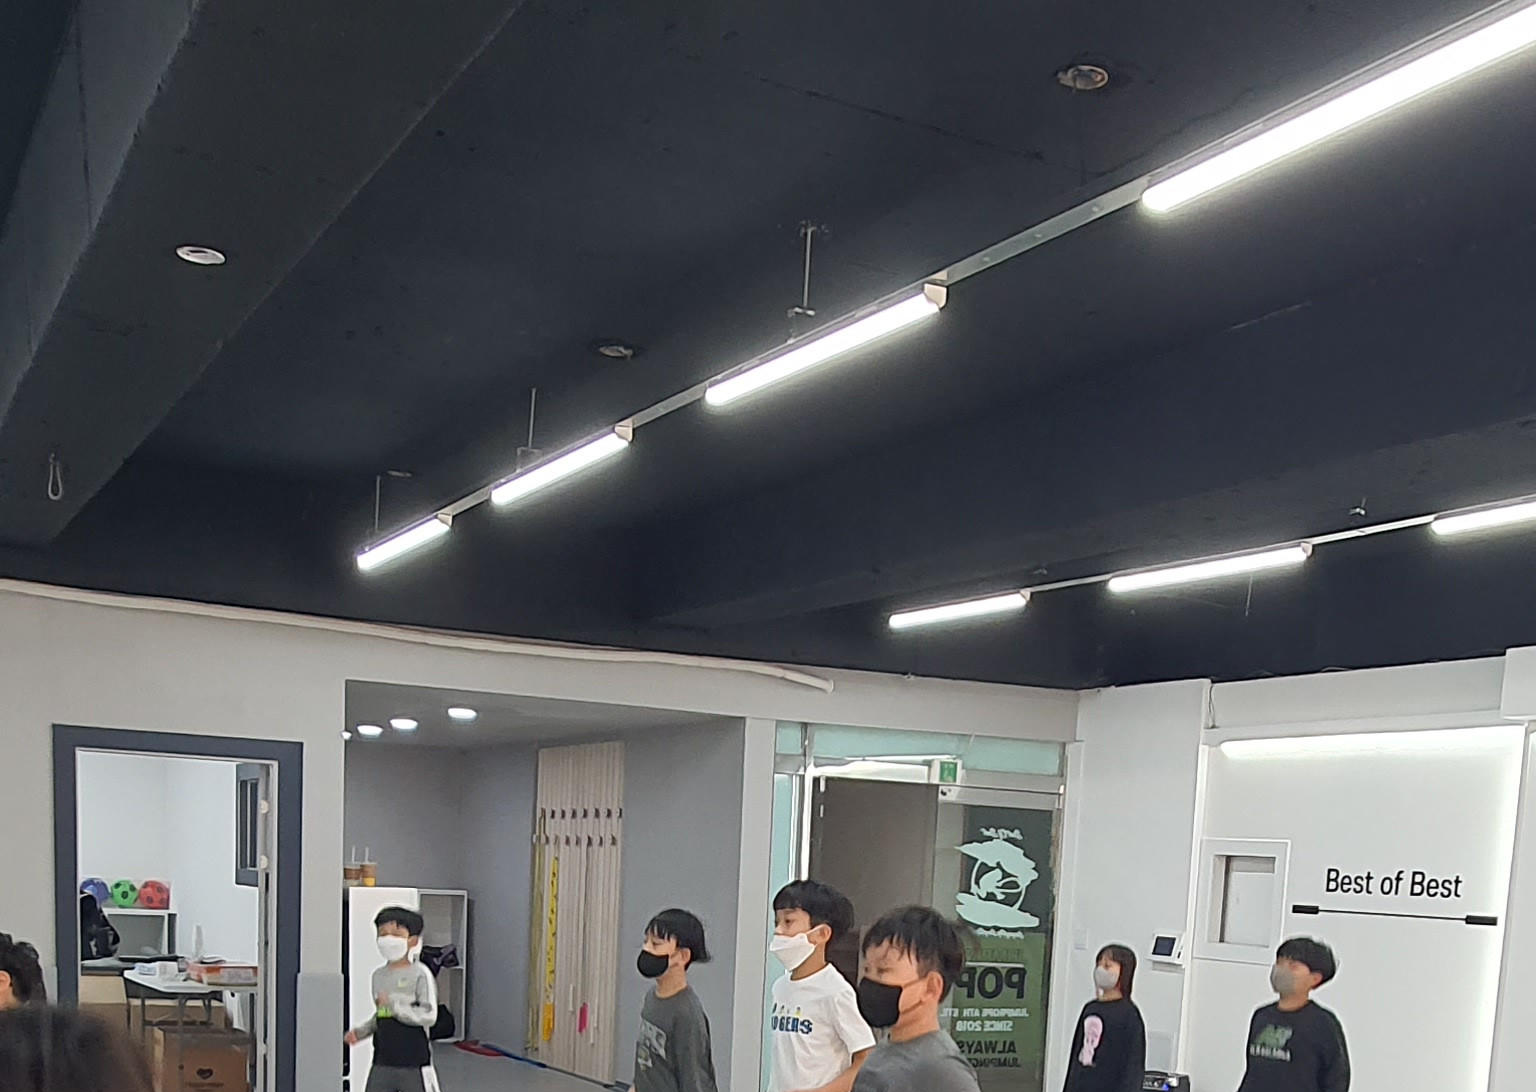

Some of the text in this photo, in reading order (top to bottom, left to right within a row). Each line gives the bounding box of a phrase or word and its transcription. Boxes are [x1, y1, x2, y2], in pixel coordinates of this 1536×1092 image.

[1325, 868, 1463, 898] Best of Best
